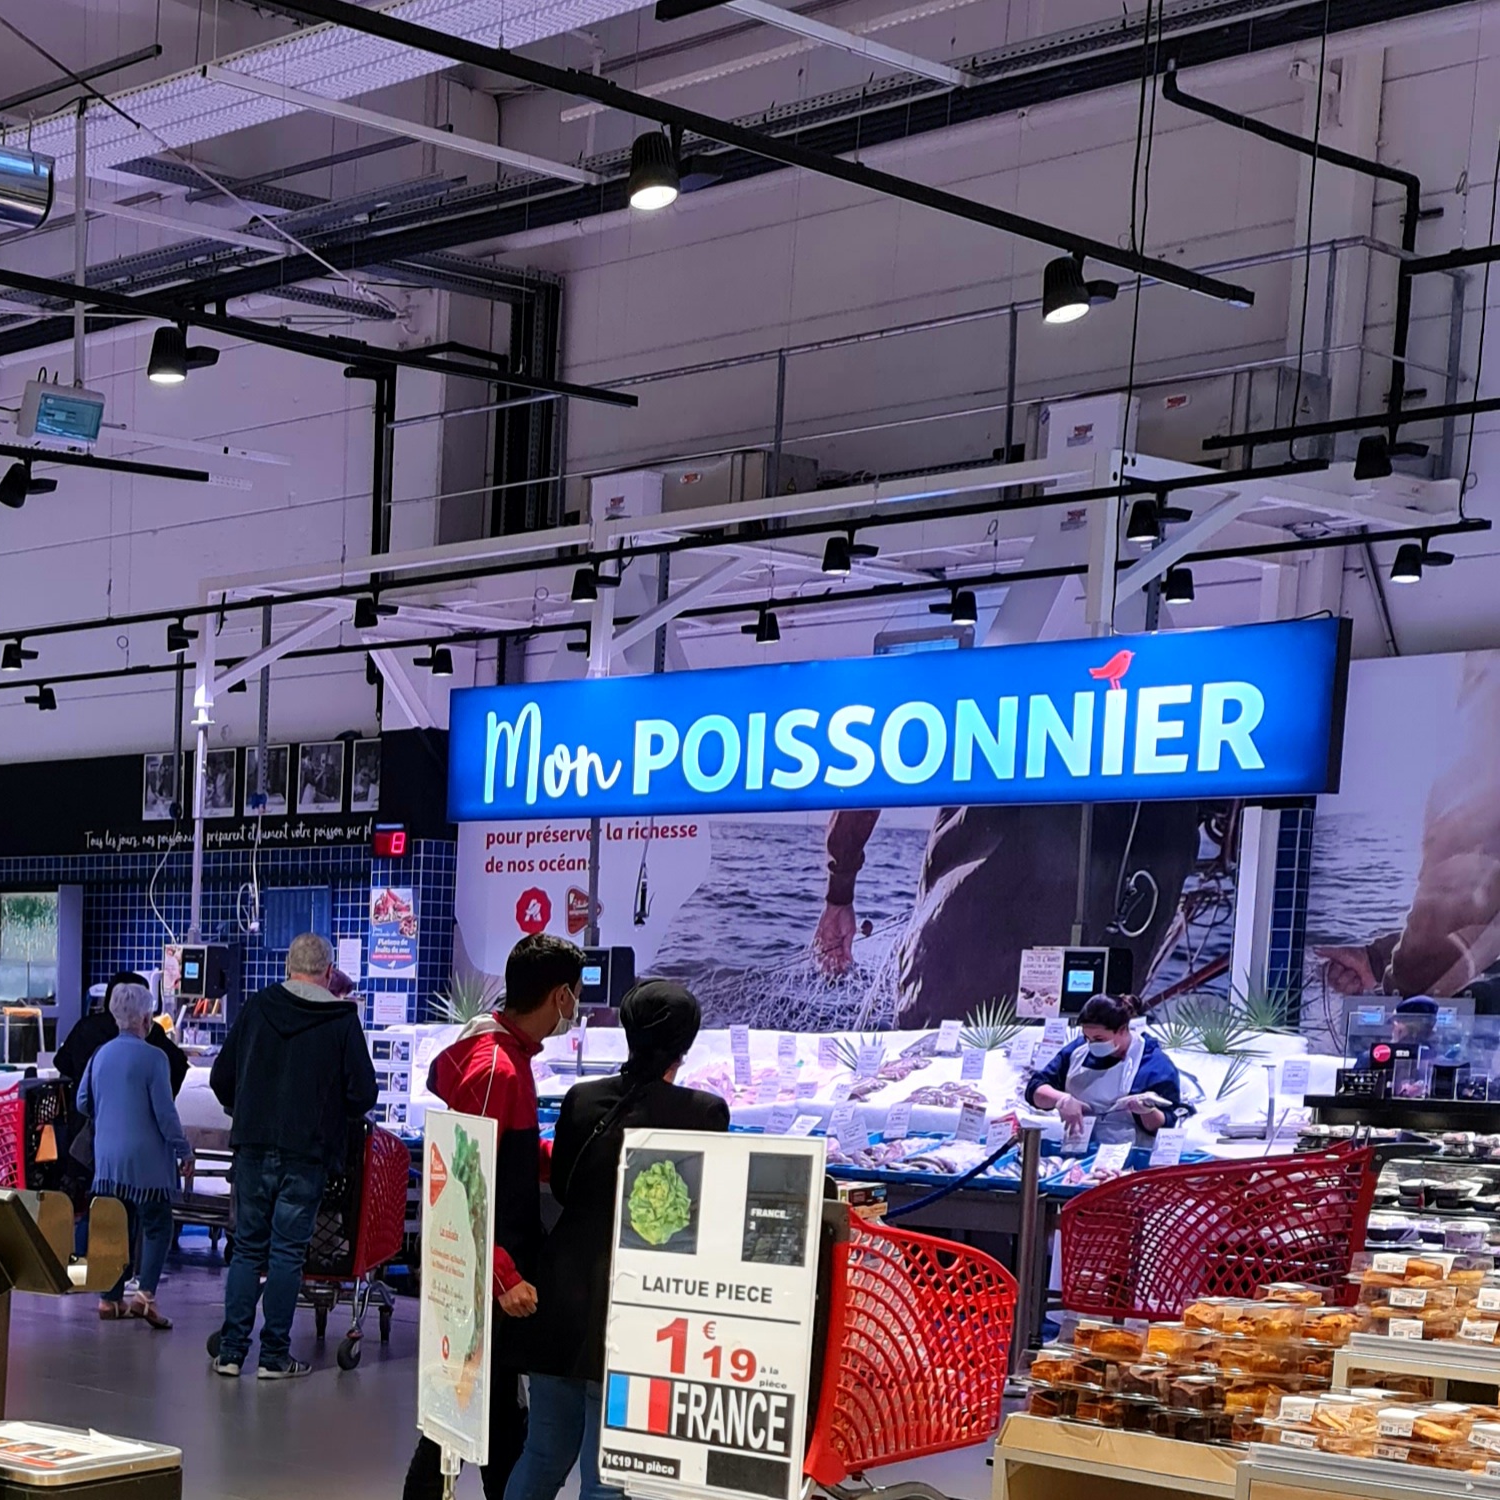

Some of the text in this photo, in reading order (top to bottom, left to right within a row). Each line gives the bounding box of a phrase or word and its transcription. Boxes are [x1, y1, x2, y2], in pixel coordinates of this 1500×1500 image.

[483, 681, 1267, 806] Mon POISSONNIER
[486, 820, 698, 850] pour préserve la richesse
[485, 854, 600, 873] de nos océan
[643, 1274, 773, 1304] LAITUE PIECE
[656, 1316, 689, 1375] 1
[702, 1344, 757, 1382] 19
[759, 1377, 787, 1390] pièce
[670, 1381, 787, 1453] FRANCE
[634, 1458, 643, 1469] la
[646, 1461, 675, 1475] pièce
